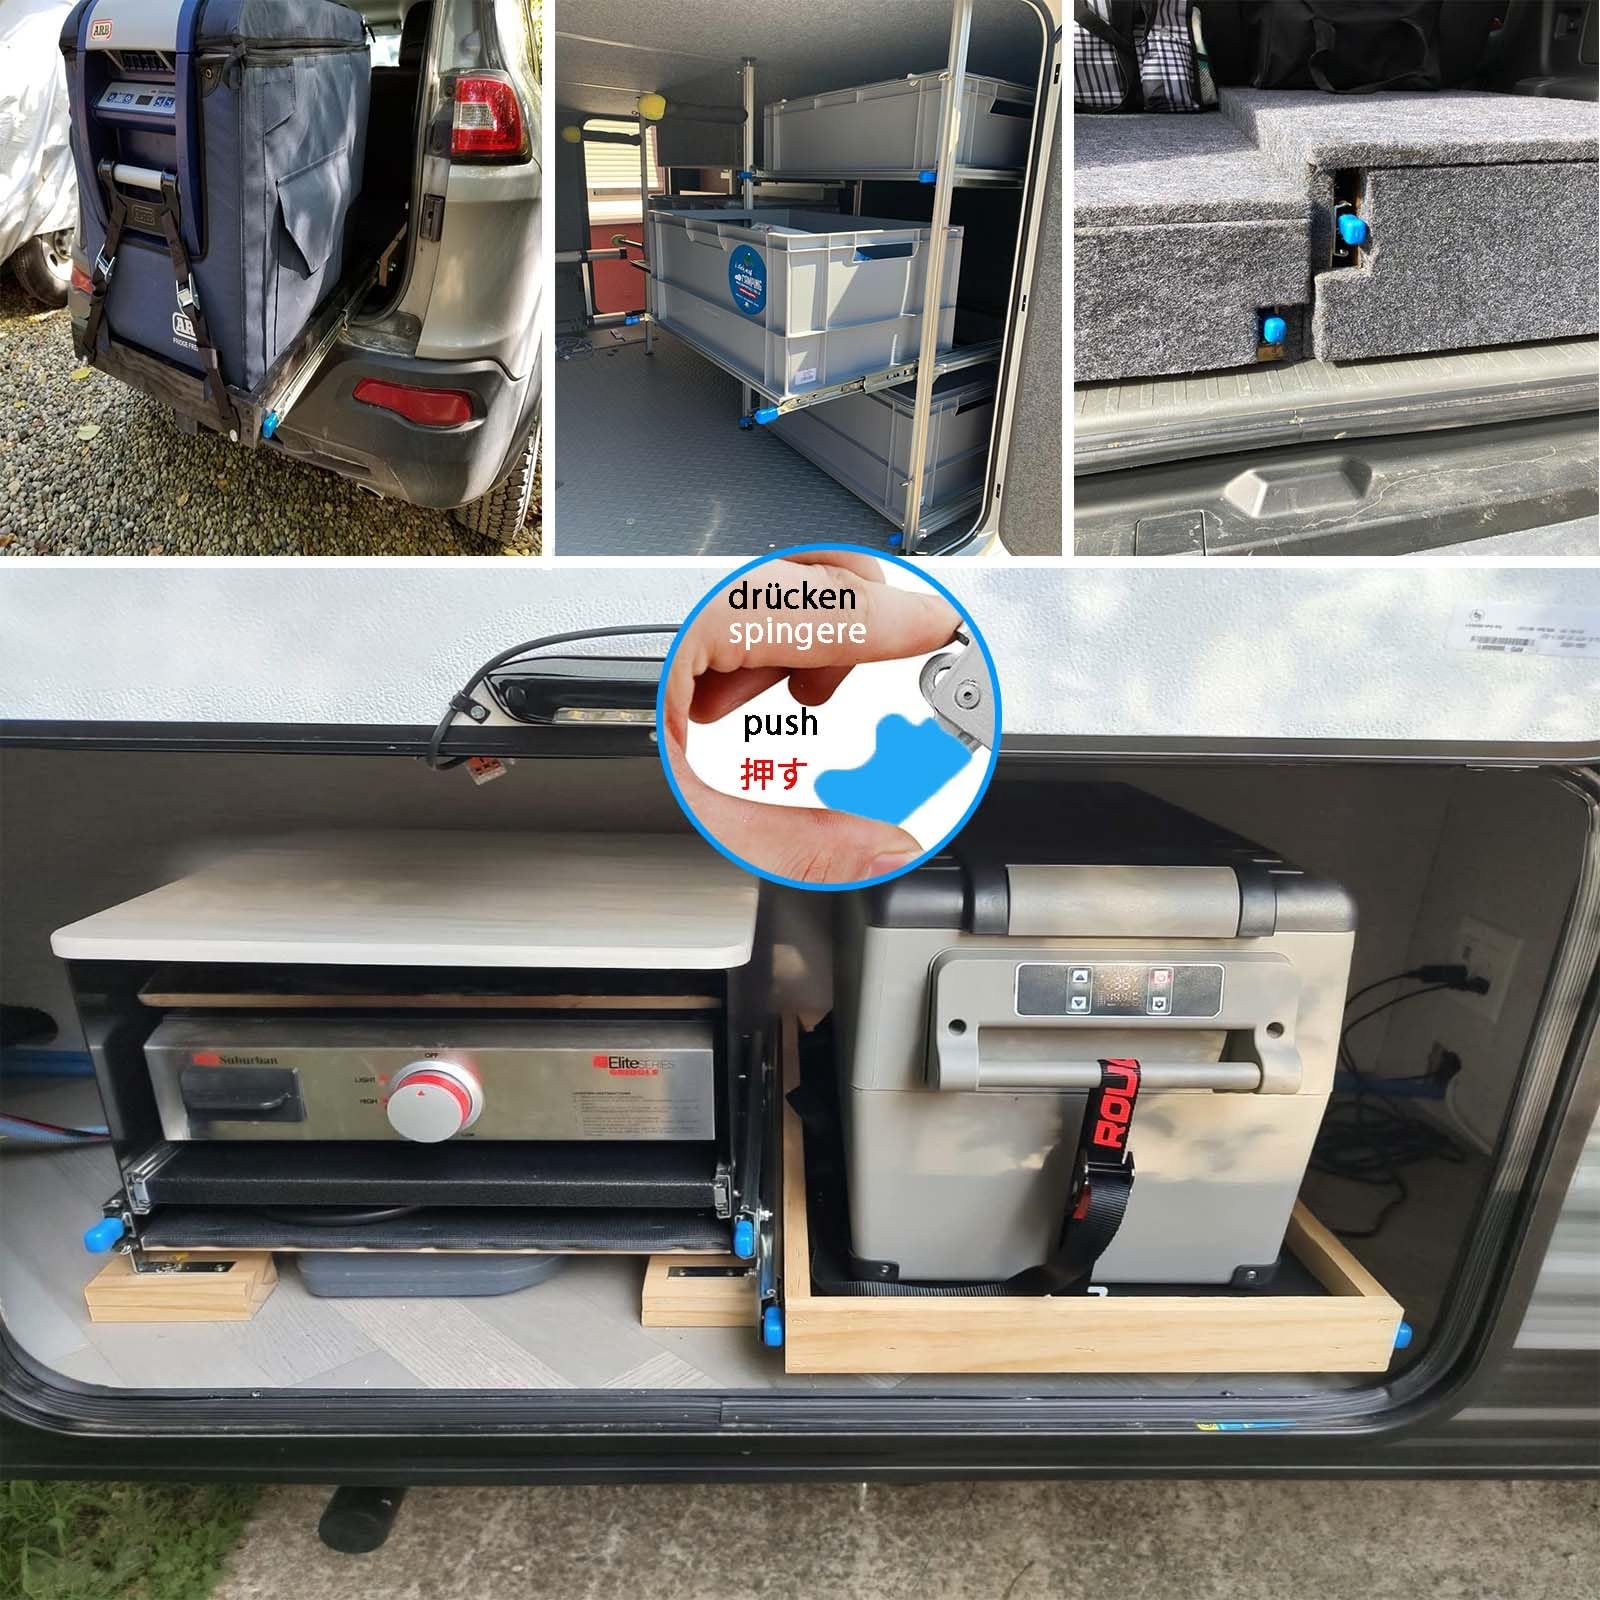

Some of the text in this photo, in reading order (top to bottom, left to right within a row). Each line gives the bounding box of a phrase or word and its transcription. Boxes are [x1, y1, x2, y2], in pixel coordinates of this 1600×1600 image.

[93, 24, 110, 36] ARB
[175, 316, 196, 337] AR
[219, 1055, 279, 1065] Suburban
